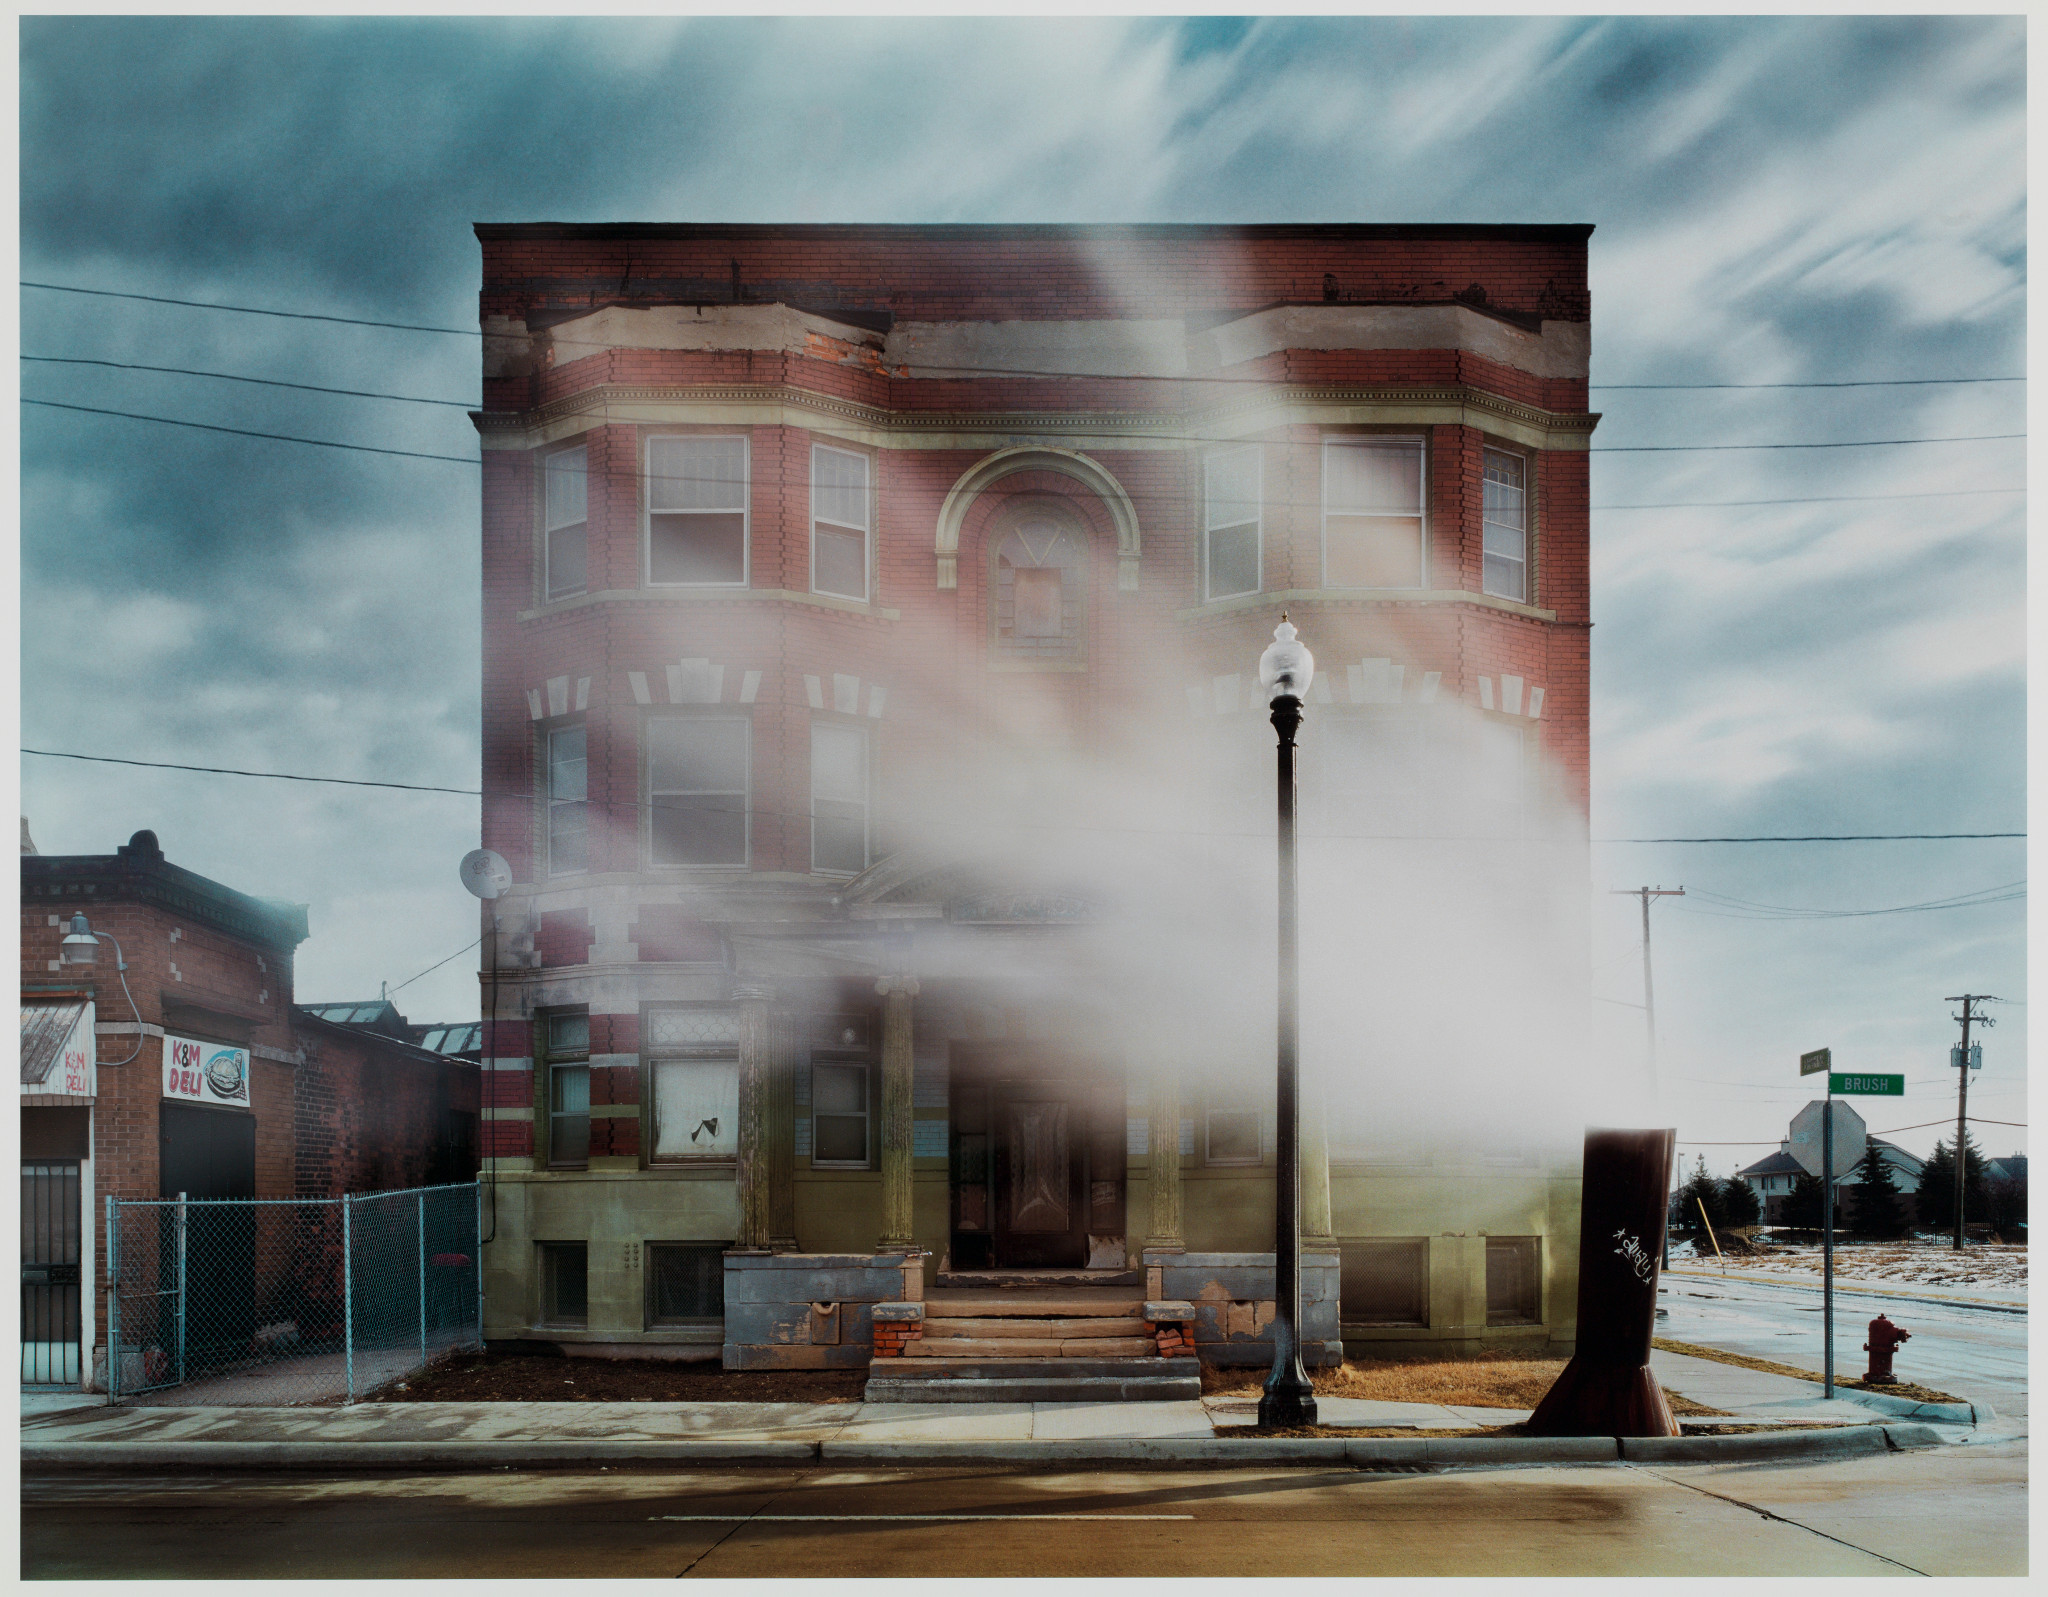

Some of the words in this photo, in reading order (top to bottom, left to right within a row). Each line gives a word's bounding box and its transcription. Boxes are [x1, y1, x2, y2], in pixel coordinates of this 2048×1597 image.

[173, 1040, 201, 1068] K&M
[66, 1073, 87, 1092] DELI
[169, 1068, 202, 1096] DELI
[1844, 1077, 1888, 1091] BRUSH
